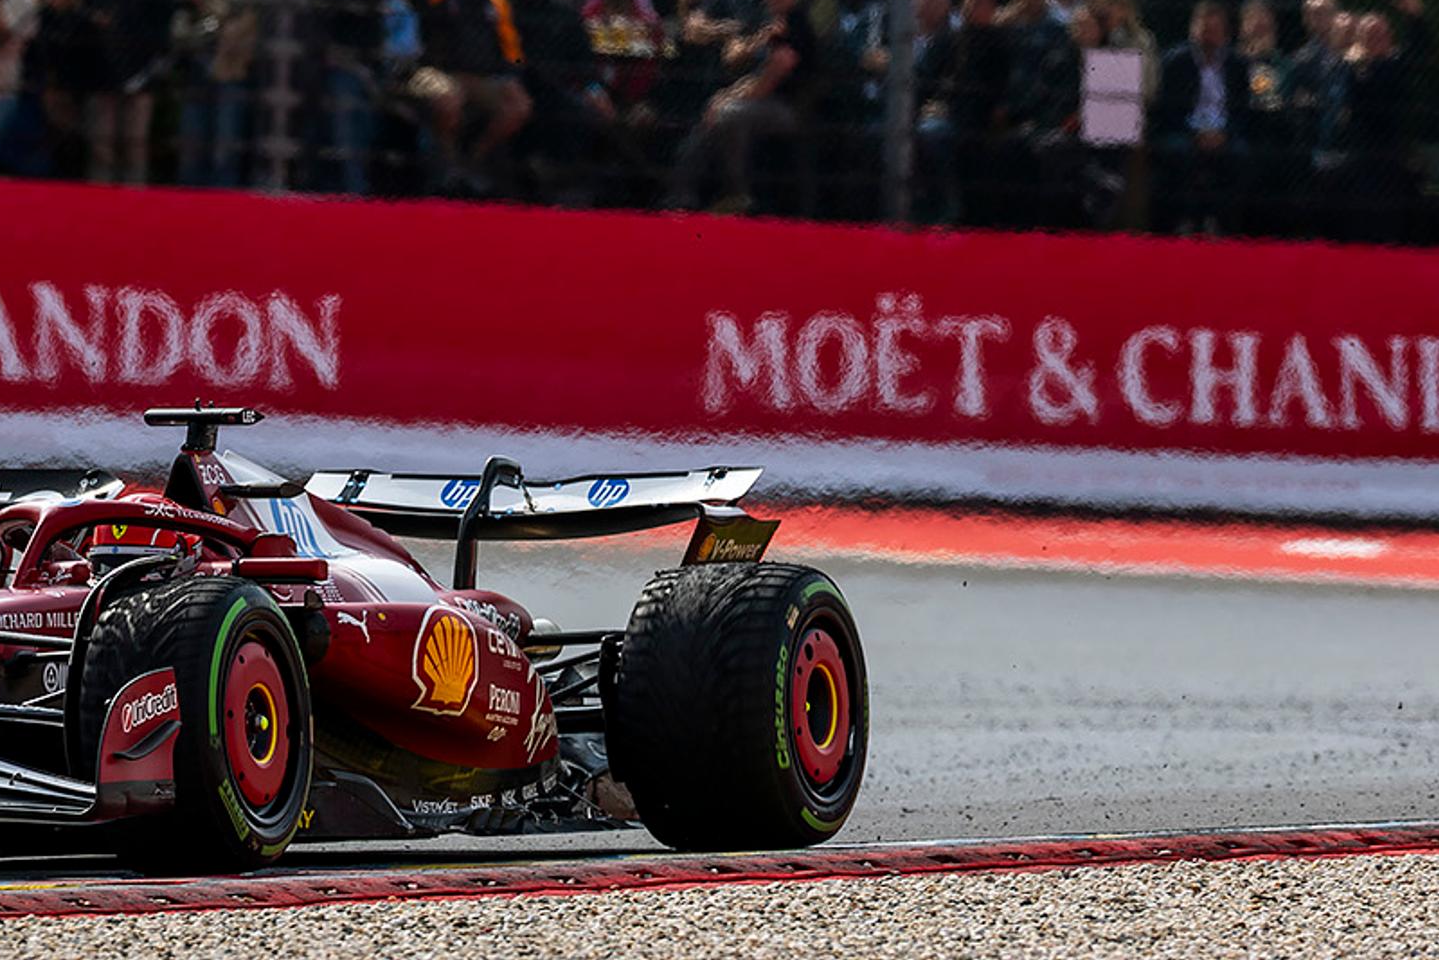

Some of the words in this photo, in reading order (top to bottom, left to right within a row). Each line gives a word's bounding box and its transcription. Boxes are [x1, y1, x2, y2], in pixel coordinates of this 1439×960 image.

[702, 290, 1011, 418] MOËT
[1028, 315, 1098, 426] &
[242, 410, 256, 424] LEC
[198, 464, 227, 486] ZCG
[588, 478, 630, 508] hp
[471, 794, 492, 809] SKF
